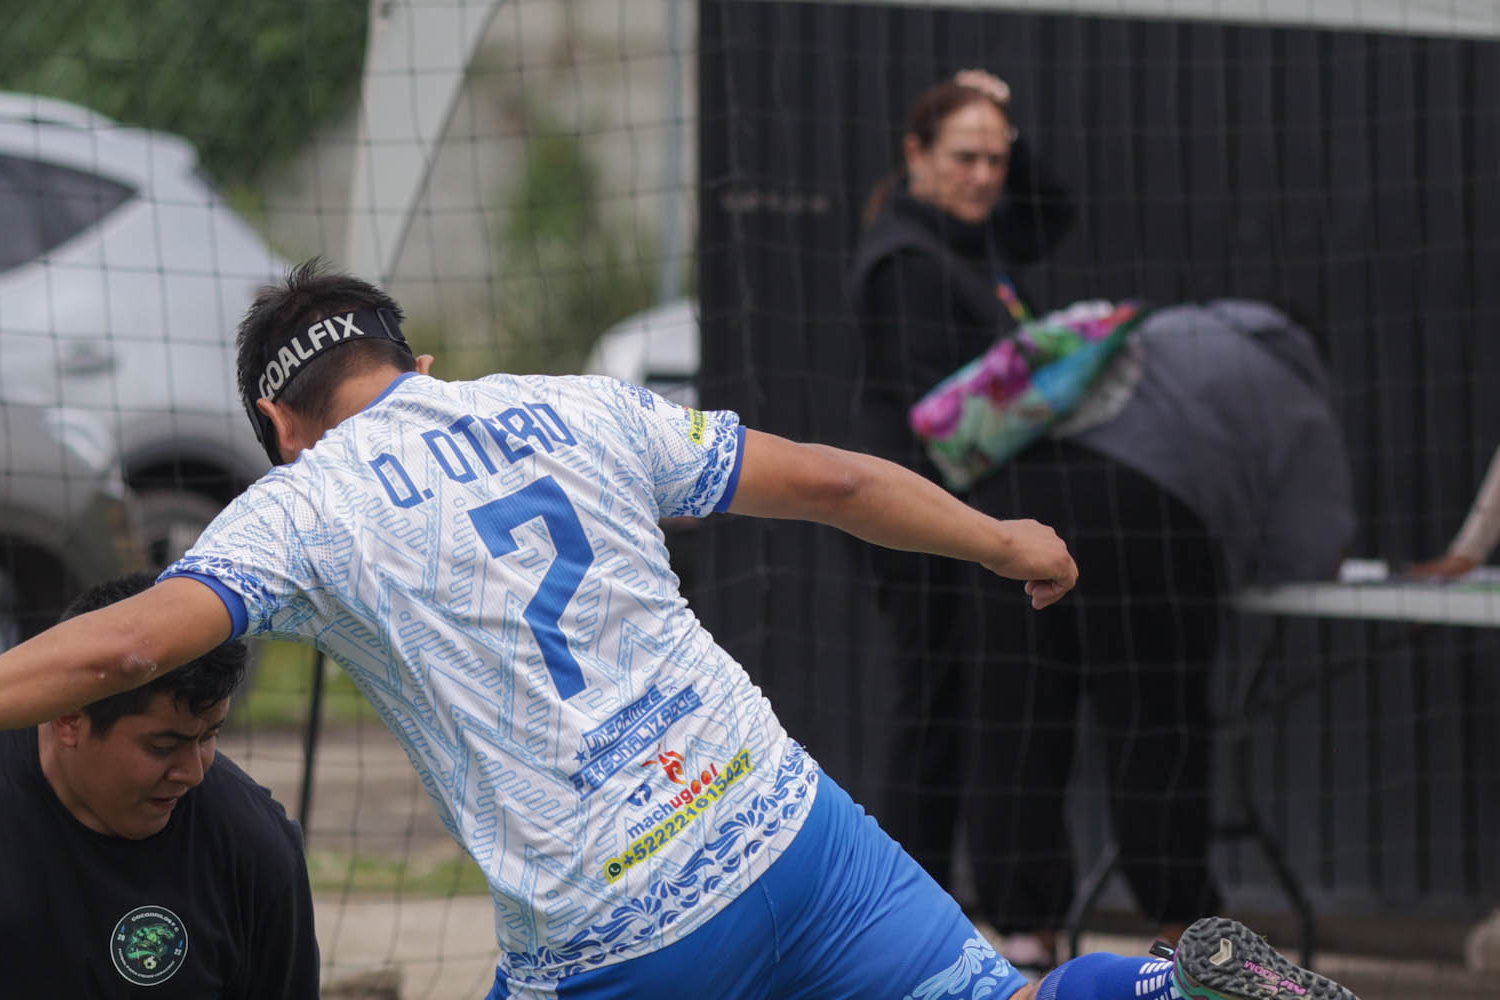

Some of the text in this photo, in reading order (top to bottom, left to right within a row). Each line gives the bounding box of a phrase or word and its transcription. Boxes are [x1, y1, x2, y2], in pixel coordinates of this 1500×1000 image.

[258, 312, 365, 401] GOALFIX
[420, 401, 577, 484] OTERO
[466, 474, 595, 701] 7
